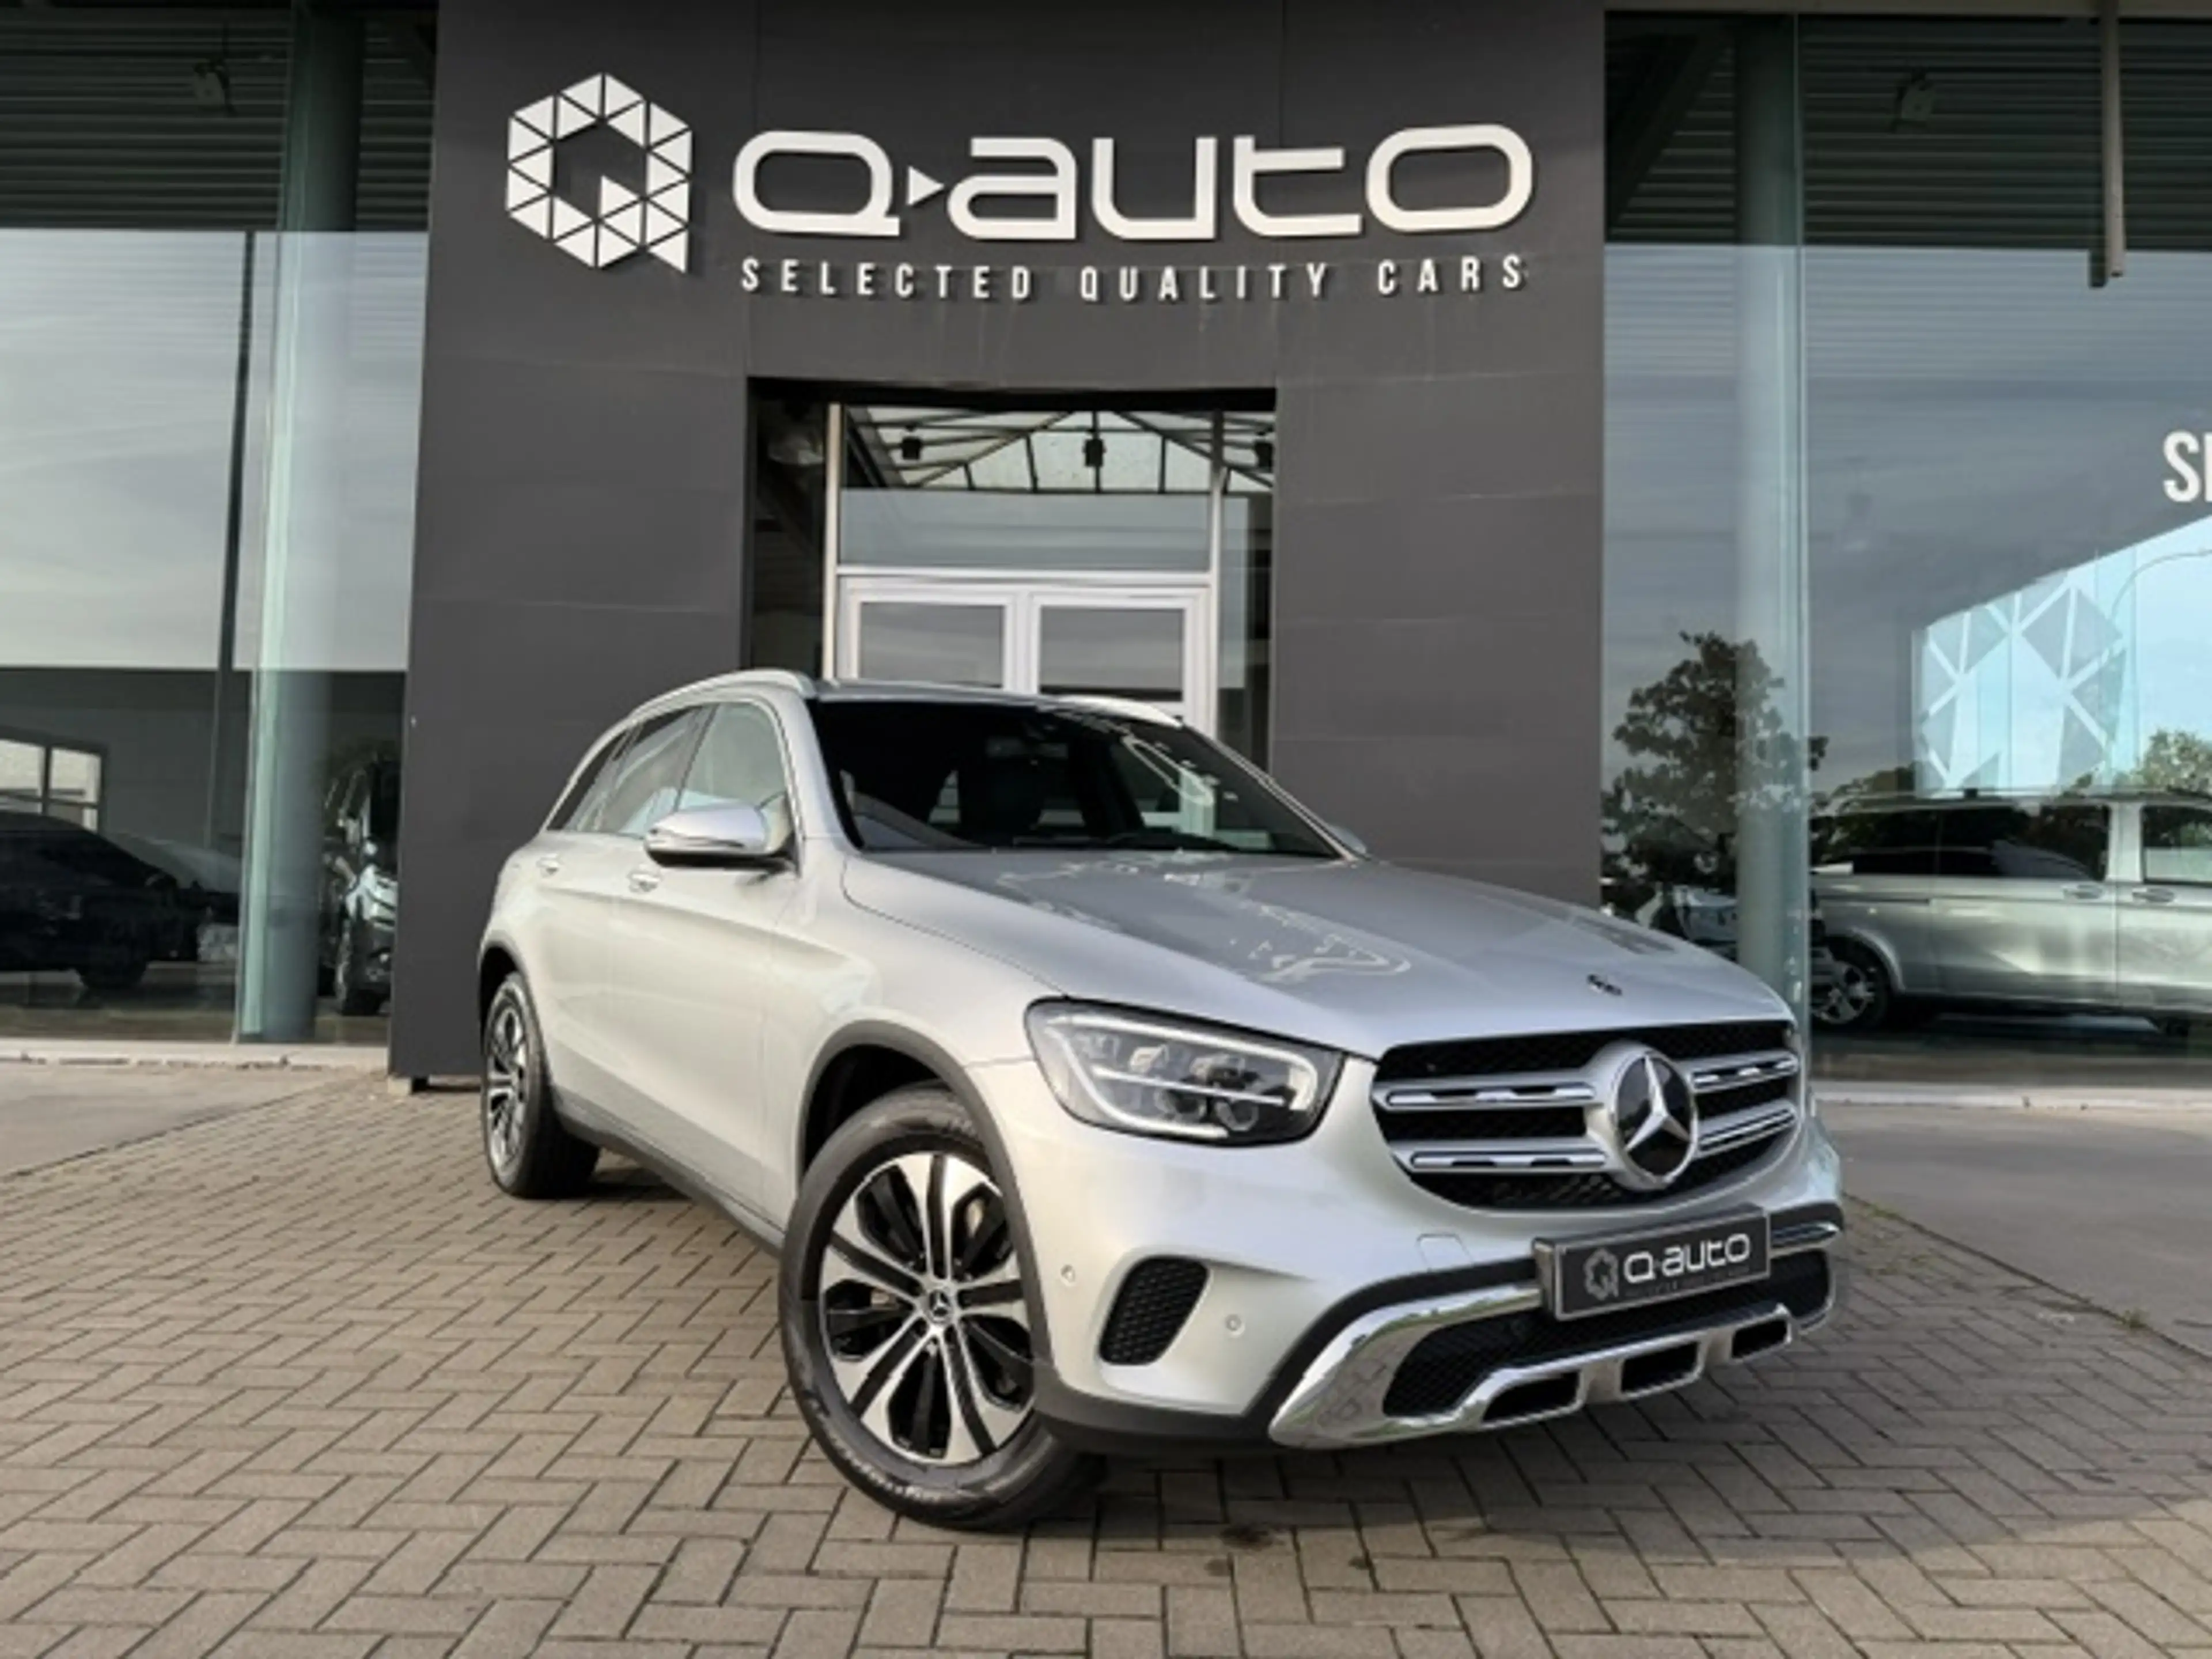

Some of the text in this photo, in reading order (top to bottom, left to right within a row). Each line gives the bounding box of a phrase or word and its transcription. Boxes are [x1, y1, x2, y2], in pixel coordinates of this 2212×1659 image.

[741, 253, 1522, 301] SELECTED QUALITY CARS
[2163, 430, 2212, 503] S
